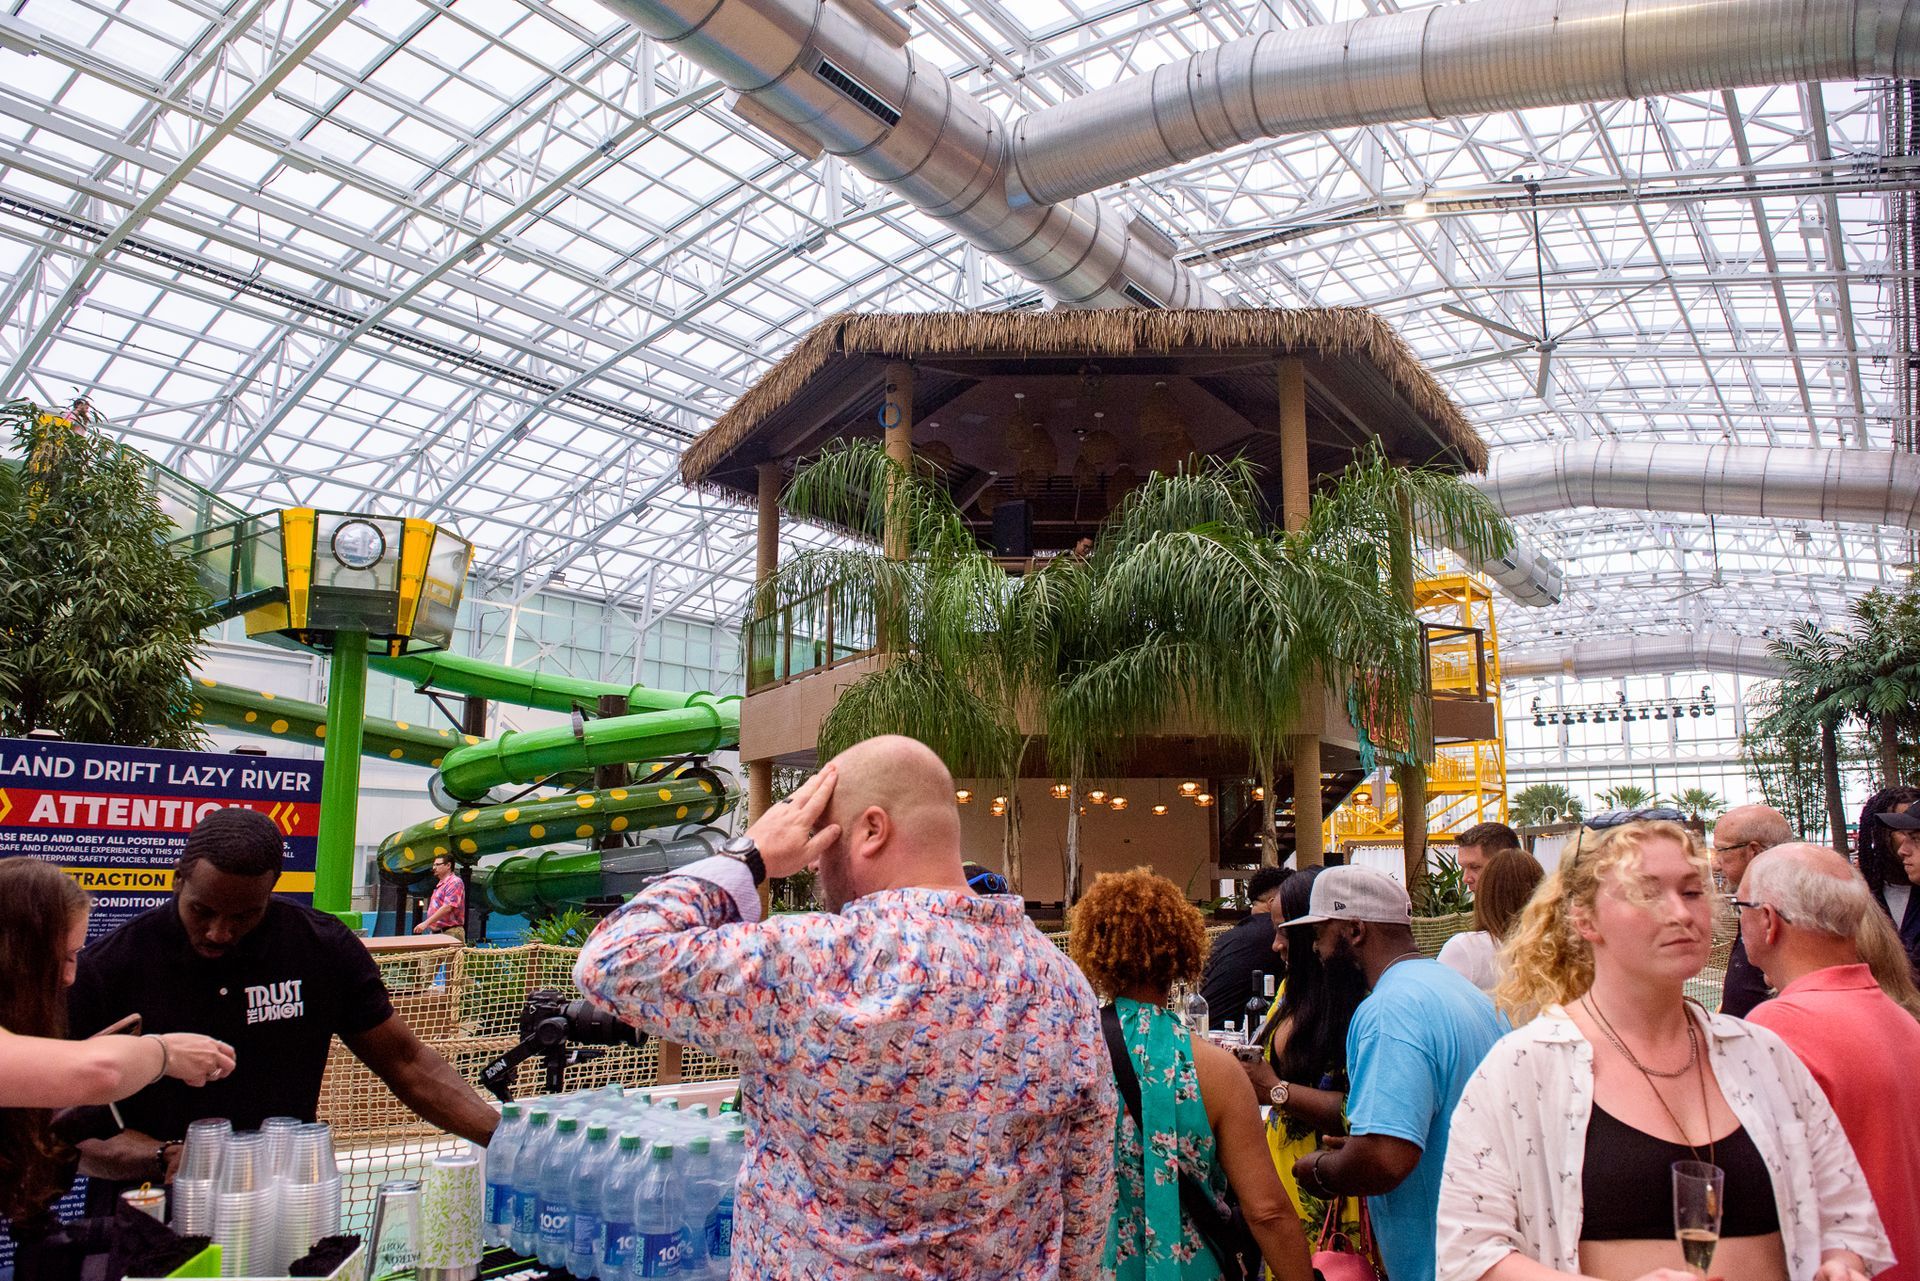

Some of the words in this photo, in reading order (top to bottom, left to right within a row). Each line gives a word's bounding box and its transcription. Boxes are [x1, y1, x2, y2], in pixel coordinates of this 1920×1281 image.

[0, 754, 75, 778] LAND
[83, 759, 161, 783] DRIFT
[168, 764, 234, 787] LAZY
[241, 769, 311, 791] RIVER
[28, 794, 252, 829] ATTENTIO
[0, 843, 20, 851] SAFE
[22, 844, 41, 852] AND
[43, 845, 89, 853] ENJOYABLE
[91, 846, 139, 854] EXPERIENCE
[141, 847, 153, 855] ON
[19, 833, 48, 842] READ
[51, 834, 74, 843] AND
[76, 835, 105, 844] OBEY
[107, 836, 125, 845] ALL
[127, 837, 166, 846] POSTED
[168, 838, 189, 847] RUL
[79, 855, 108, 863] SAFETY
[110, 856, 149, 865] POLICIES,
[69, 872, 166, 887] TRACTION
[244, 979, 302, 1008] TRUST
[246, 1008, 258, 1025] THE
[258, 1001, 304, 1023] VISION
[485, 1058, 507, 1079] RONIN
